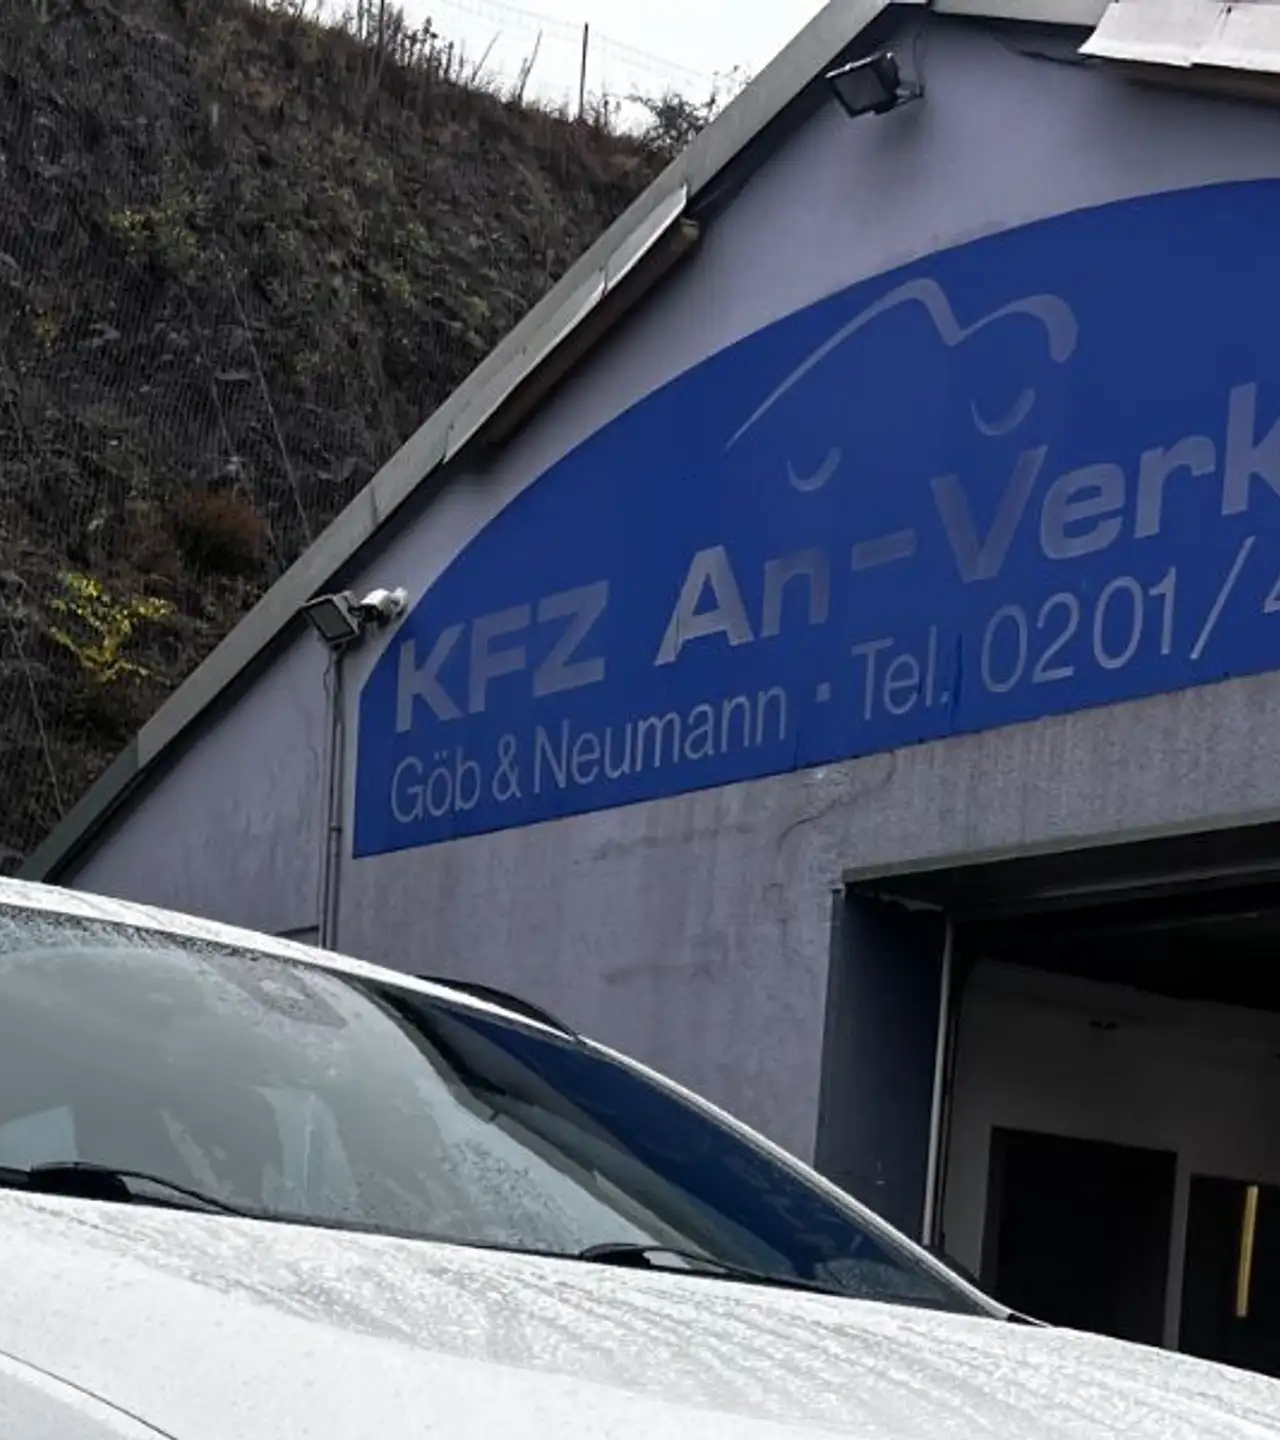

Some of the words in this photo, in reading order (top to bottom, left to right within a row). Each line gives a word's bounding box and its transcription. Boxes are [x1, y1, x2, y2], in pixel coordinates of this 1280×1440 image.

[390, 749, 481, 824] Göb
[492, 732, 522, 801] &
[533, 684, 787, 793] Neumann
[851, 624, 951, 721] Tel.
[395, 580, 609, 733] KFZ
